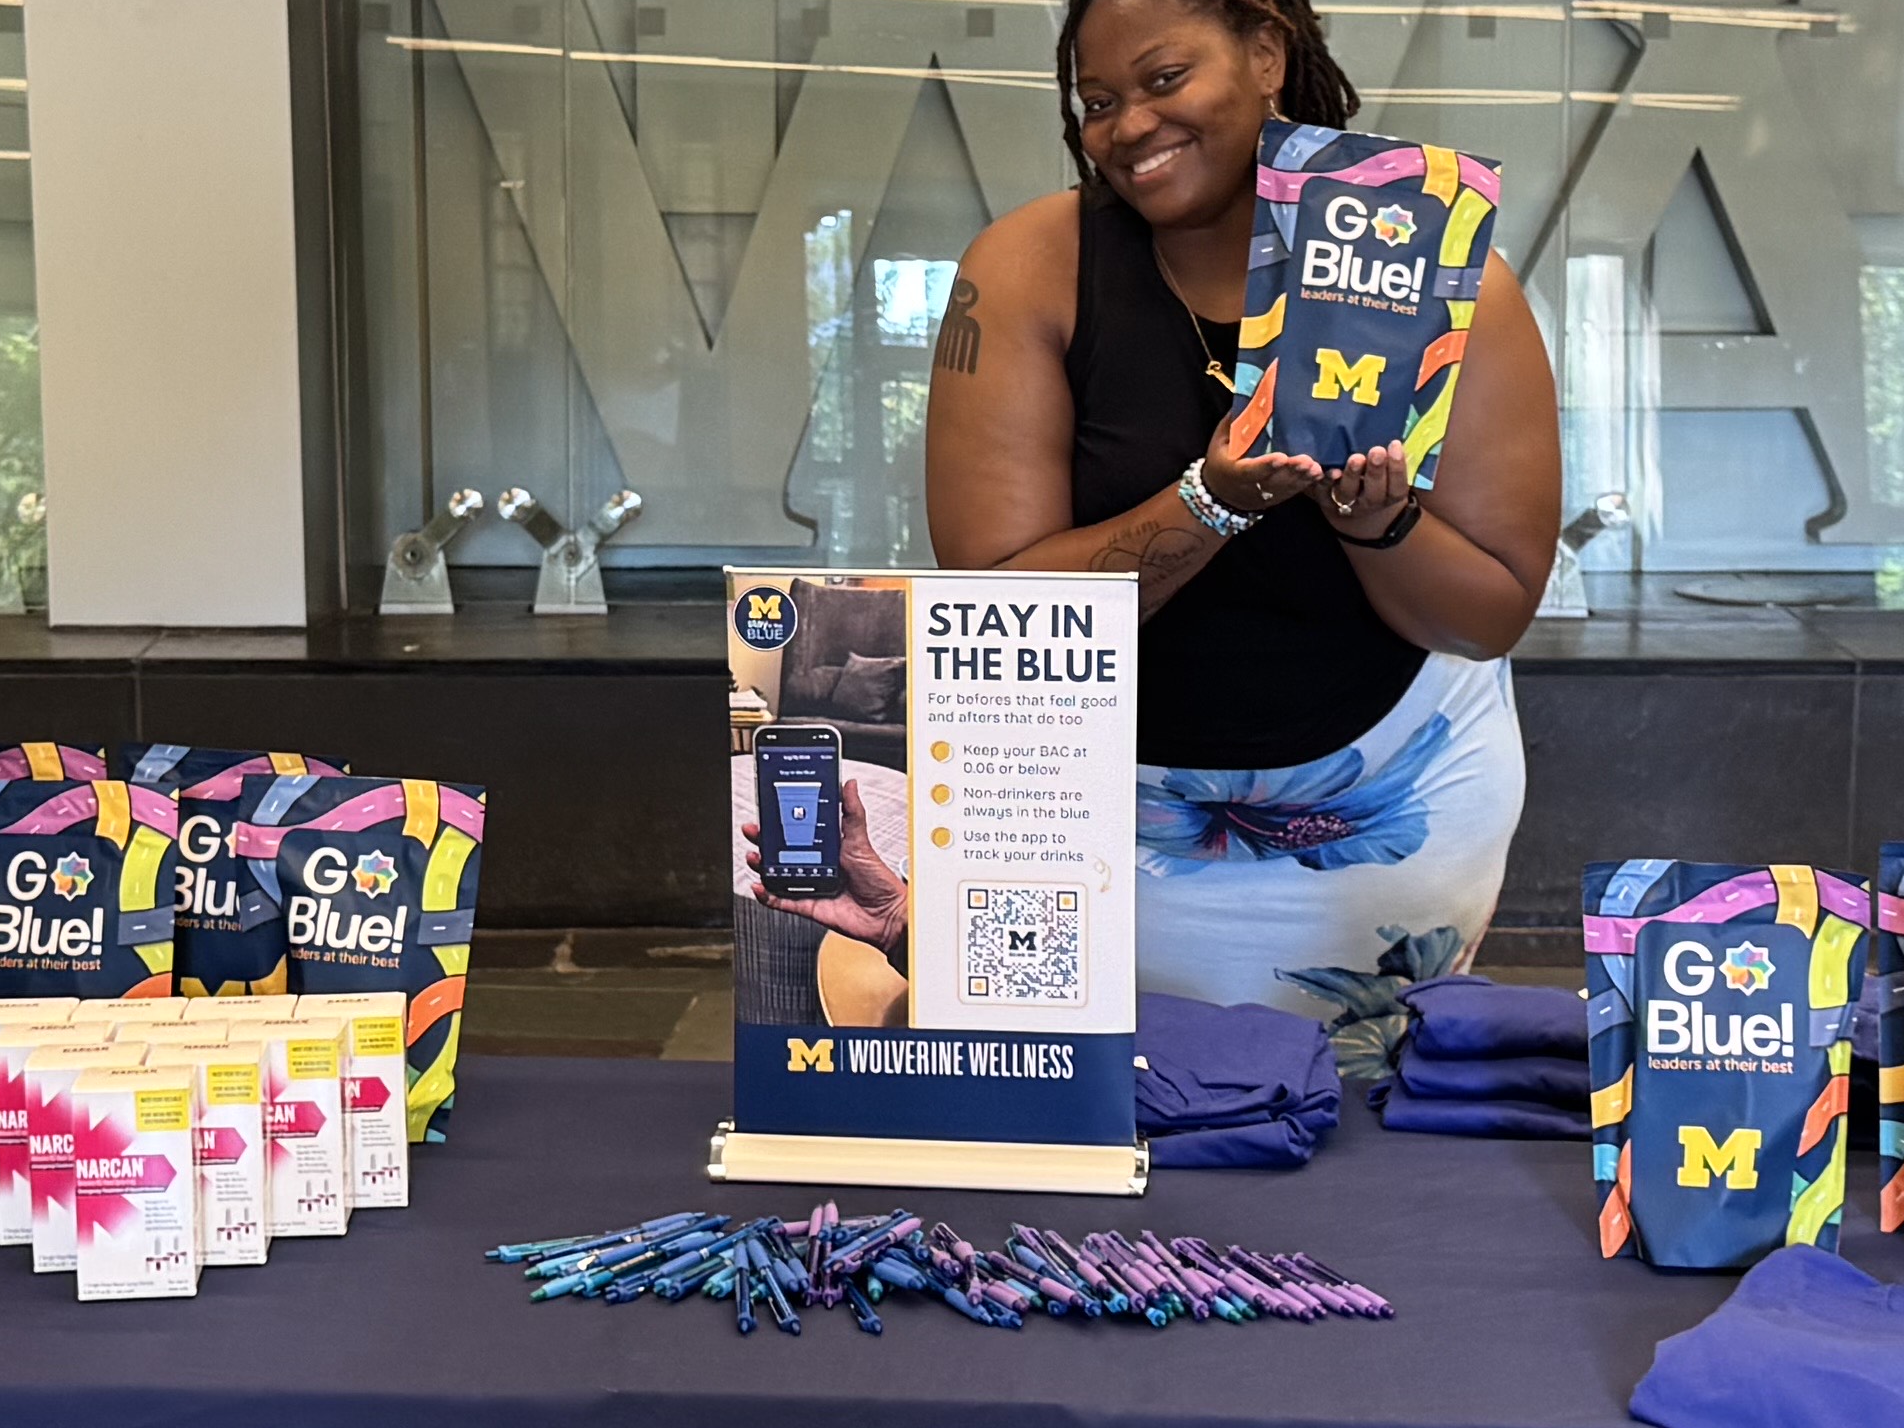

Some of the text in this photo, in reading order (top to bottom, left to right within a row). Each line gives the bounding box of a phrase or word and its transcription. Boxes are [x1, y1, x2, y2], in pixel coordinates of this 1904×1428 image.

[1301, 240, 1426, 303] Blue!
[1301, 288, 1418, 316] leaders at their best
[1312, 348, 1387, 407] M
[748, 595, 781, 619] M
[928, 603, 1092, 638] STAY IN
[747, 628, 783, 640] BLUE
[927, 647, 1116, 682] THE BLUE
[928, 693, 1117, 710] For befores that feel good
[928, 711, 1083, 725] and afters that do too
[963, 745, 1087, 759] Keep your BAC at
[963, 762, 1061, 775] 0.06 or below
[963, 788, 1083, 801] Non-drinkers are
[963, 806, 1090, 819] always in the blue
[963, 831, 1066, 845] Use the app to
[963, 849, 1084, 862] track your drinks
[288, 896, 408, 954] Blue!
[1008, 930, 1037, 951] M
[26, 957, 39, 969] at
[41, 958, 69, 970] their
[72, 959, 101, 970] best
[323, 951, 400, 969] at their best
[1647, 999, 1794, 1059] Blue!
[787, 1038, 1074, 1080] M WOLVERINE WELLNESS
[1648, 1055, 1794, 1075] leaders at their best
[1676, 1126, 1763, 1190] M
[76, 1158, 145, 1179] NARCAN
